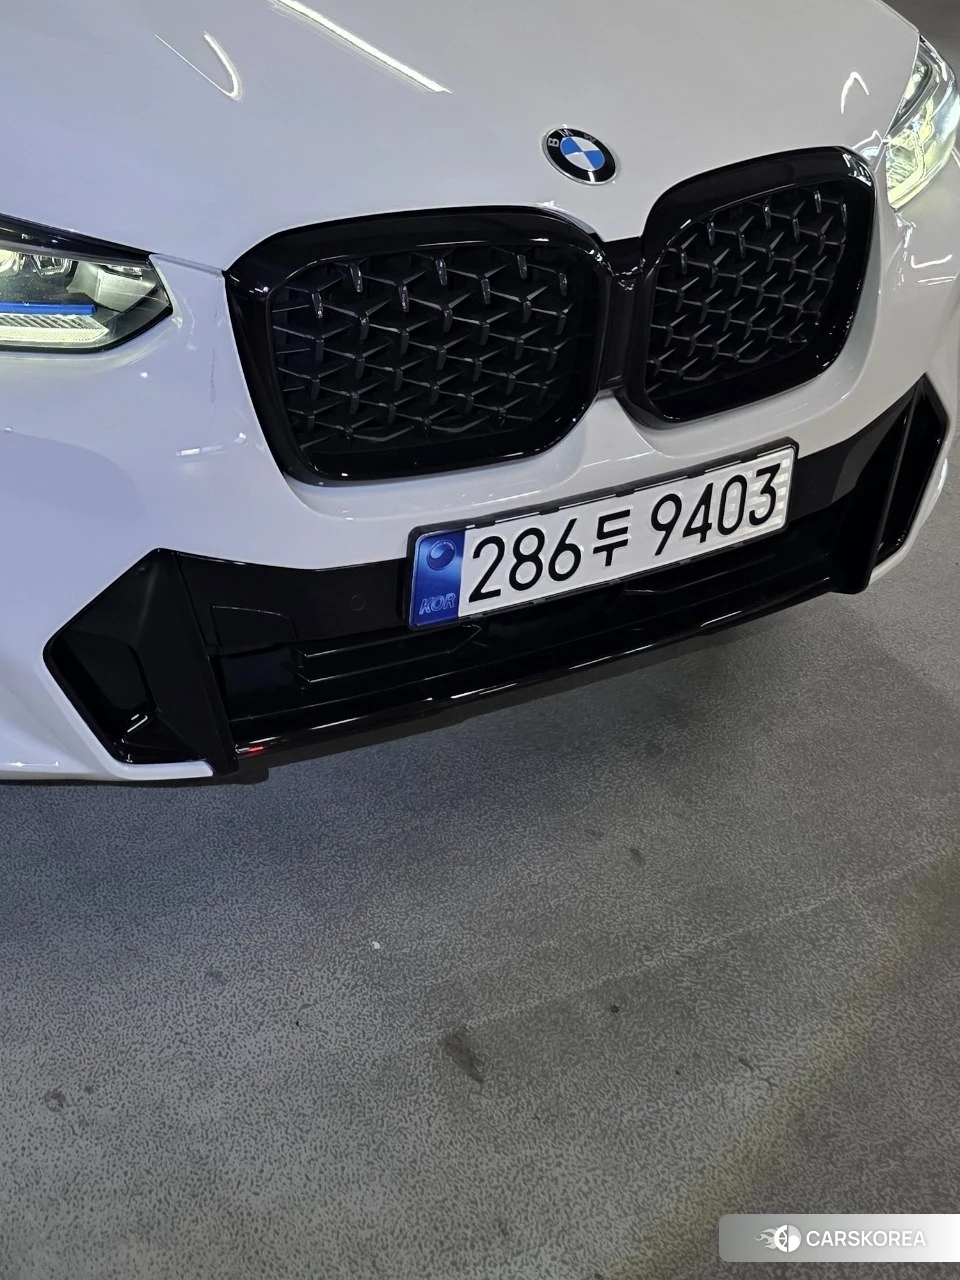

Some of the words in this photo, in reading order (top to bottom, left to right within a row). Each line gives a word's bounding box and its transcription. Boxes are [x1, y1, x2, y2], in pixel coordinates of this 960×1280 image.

[468, 509, 631, 603] 286두
[650, 463, 782, 557] 9403
[419, 592, 456, 615] KOR
